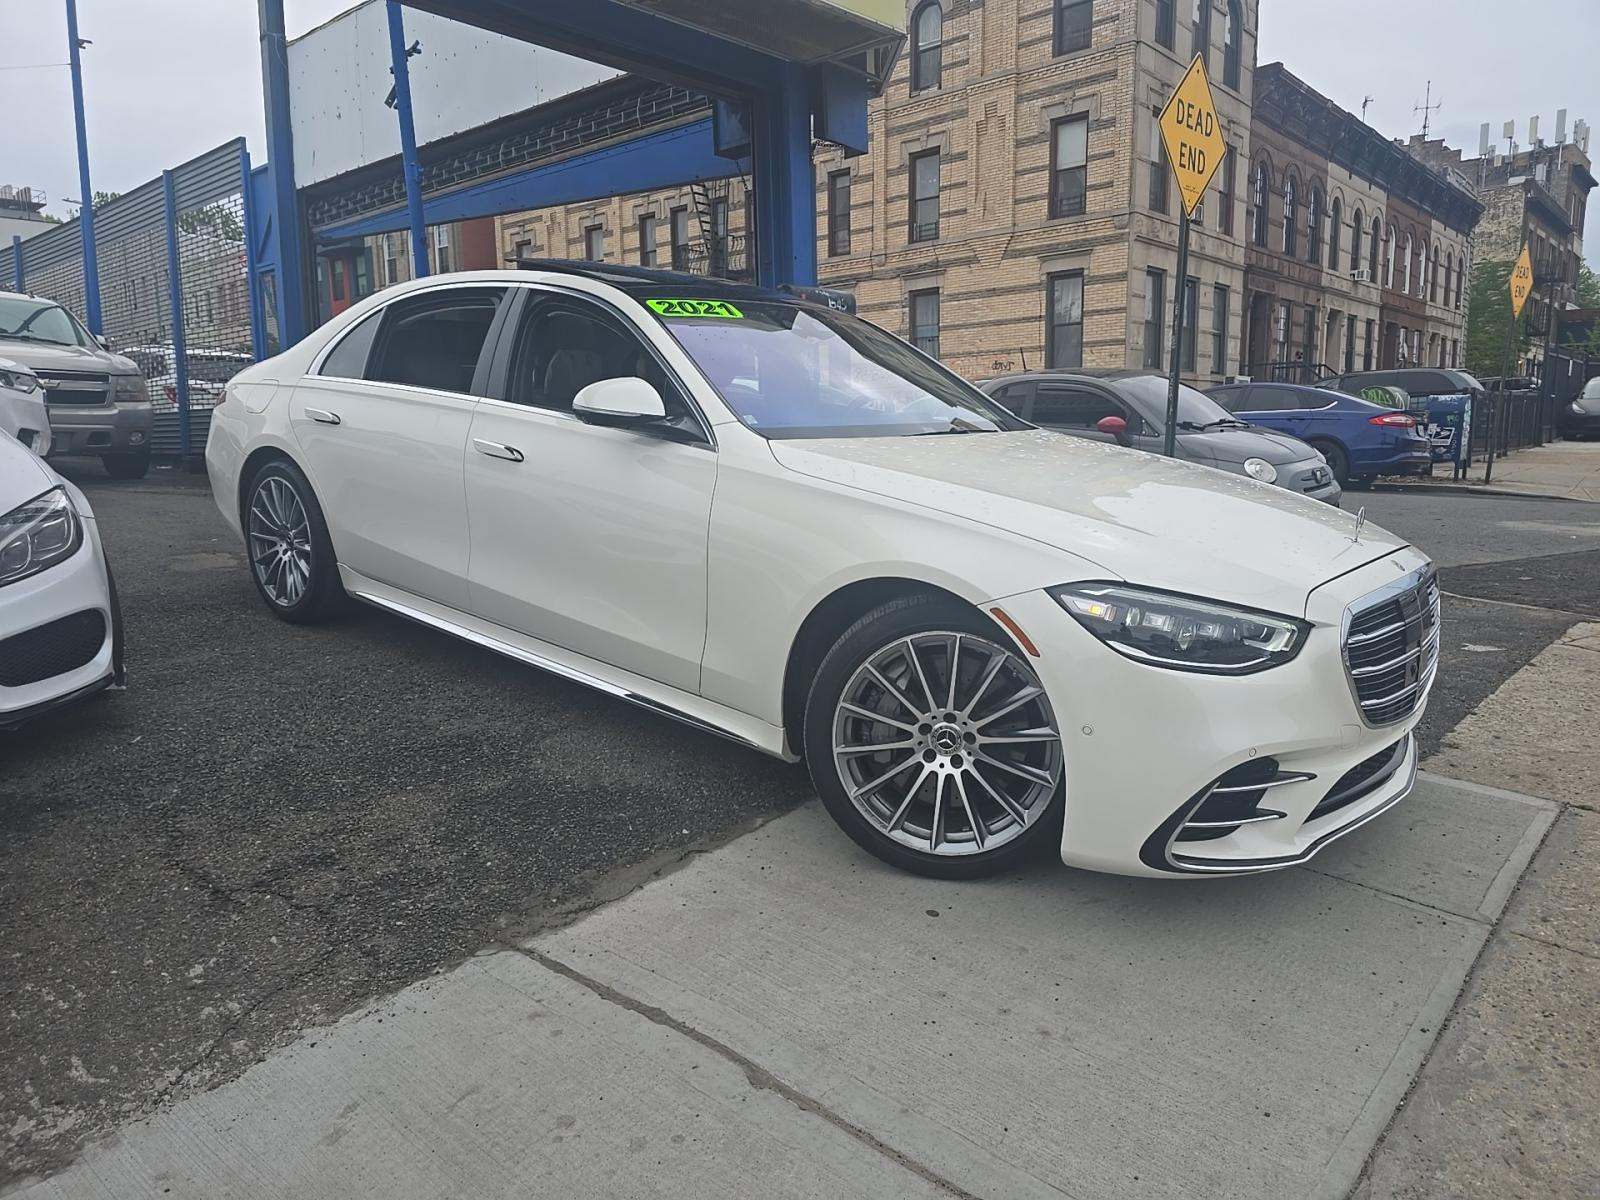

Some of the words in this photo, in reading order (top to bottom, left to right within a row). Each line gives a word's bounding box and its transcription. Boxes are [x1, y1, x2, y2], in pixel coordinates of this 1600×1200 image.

[1176, 98, 1213, 137] DEAD
[1178, 141, 1206, 175] END
[1515, 265, 1530, 279] DEAD
[1514, 284, 1525, 298] END
[655, 300, 738, 317] 2021
